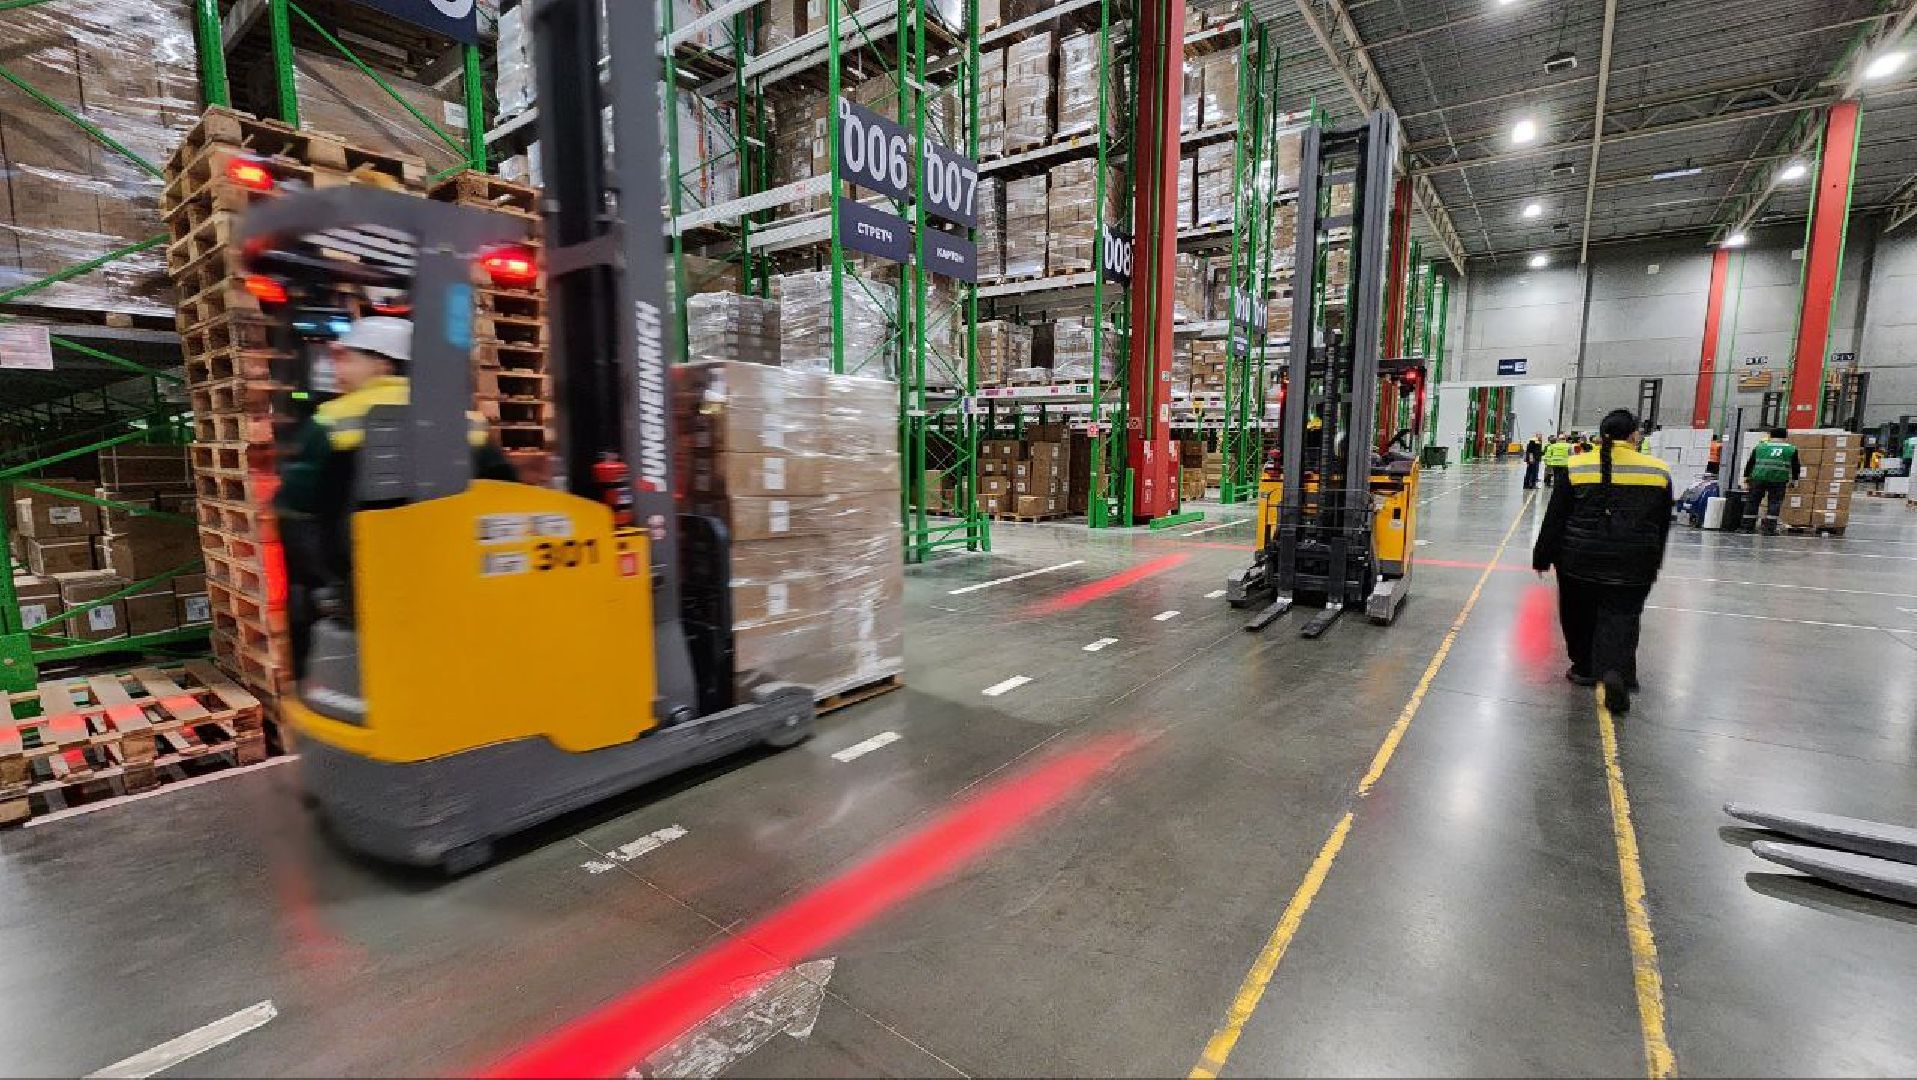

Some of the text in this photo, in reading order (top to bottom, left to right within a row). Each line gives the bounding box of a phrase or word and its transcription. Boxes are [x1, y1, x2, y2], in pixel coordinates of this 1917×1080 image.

[857, 222, 893, 243] СТРЕТЧ
[635, 300, 668, 492] JUNGHEINRICH
[535, 538, 600, 572] 301
